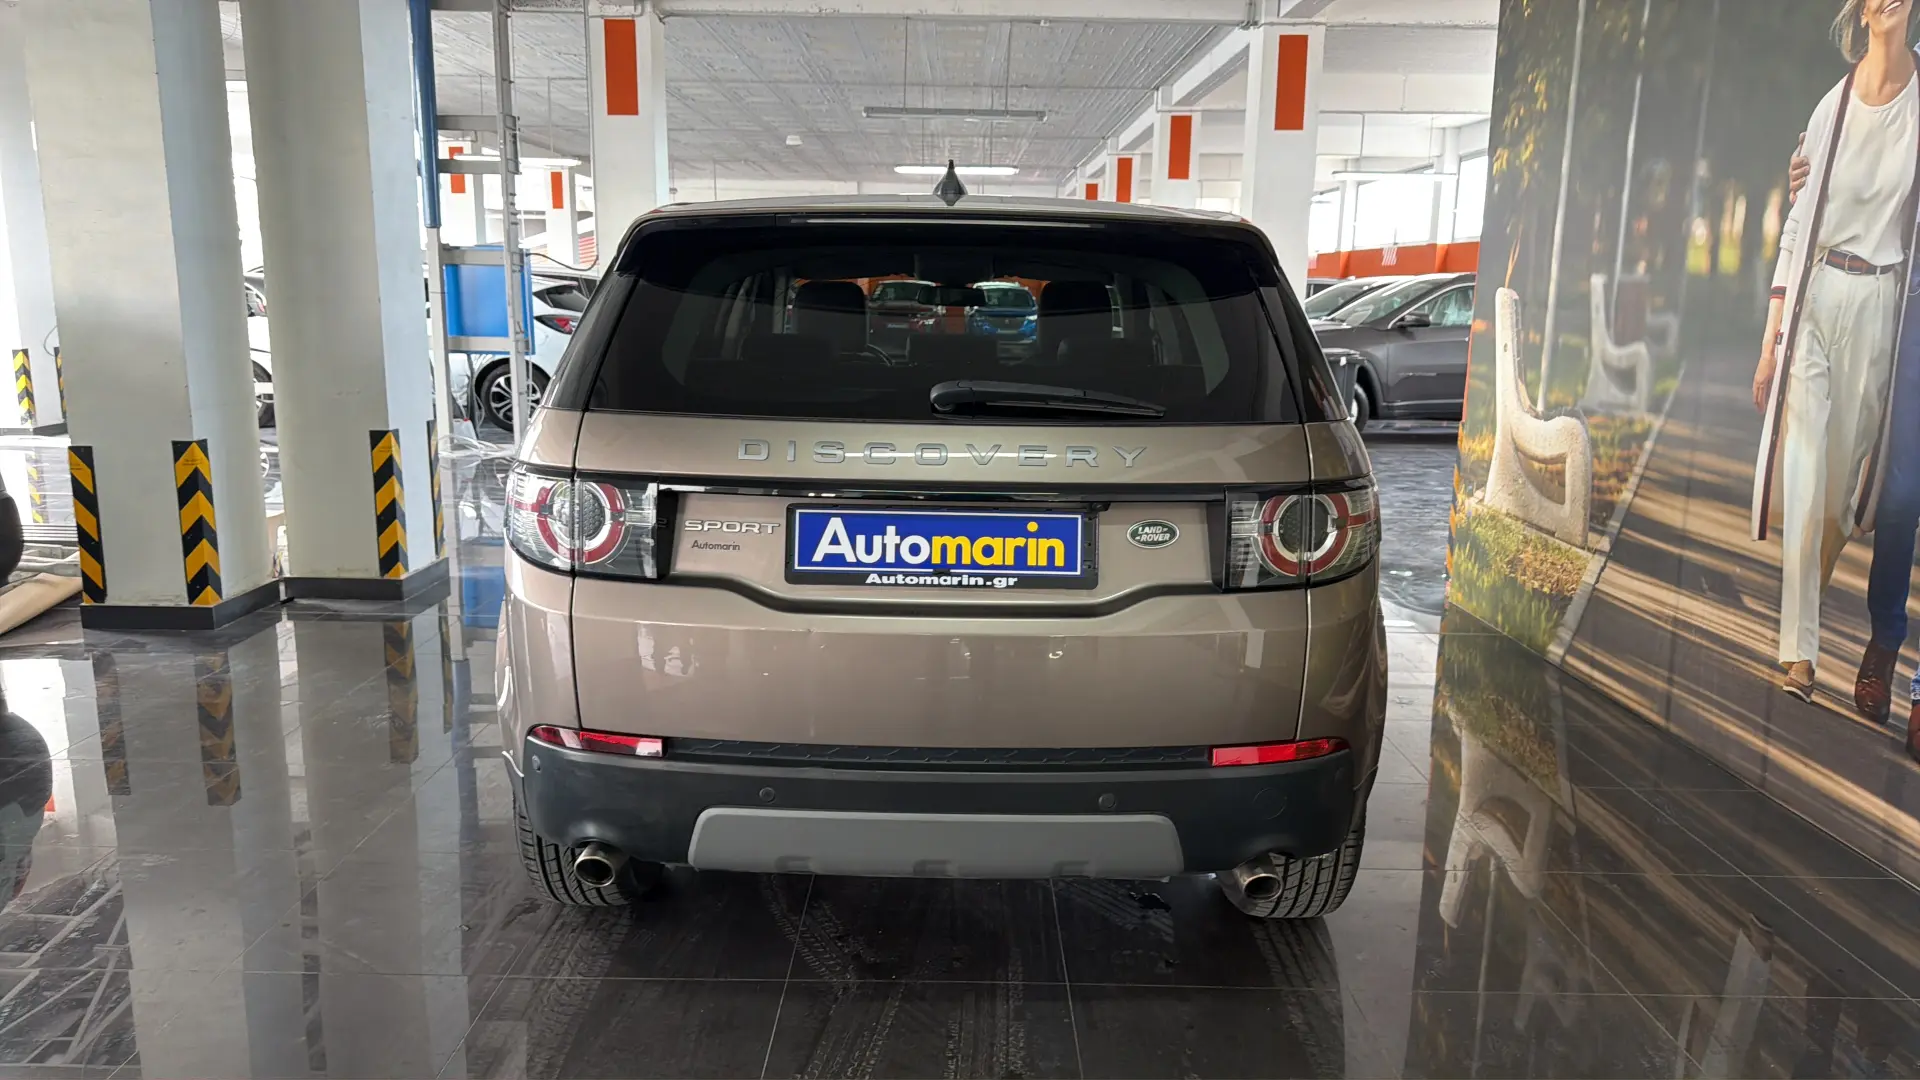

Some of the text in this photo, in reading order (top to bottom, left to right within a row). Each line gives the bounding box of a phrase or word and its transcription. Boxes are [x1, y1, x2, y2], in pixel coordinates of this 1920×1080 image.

[738, 438, 1147, 468] DISCOVERY
[684, 520, 780, 534] SPORT
[812, 517, 1065, 567] Automarin
[1140, 533, 1171, 542] ROVER
[691, 540, 741, 551] Automarin
[865, 573, 1018, 588] Automarin.gr
